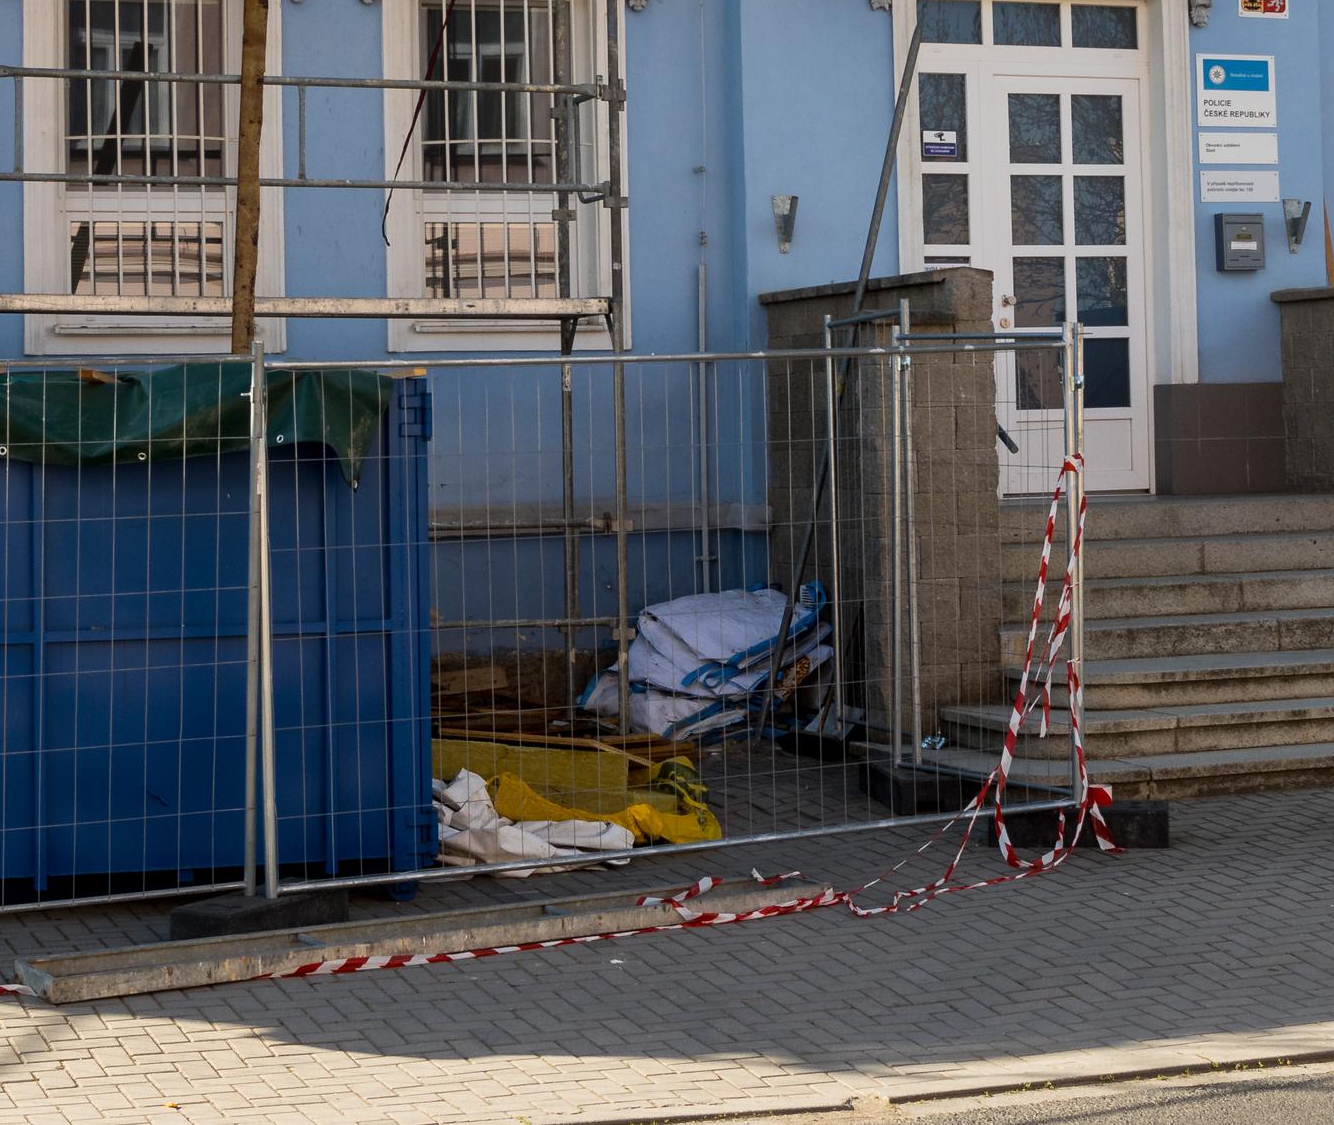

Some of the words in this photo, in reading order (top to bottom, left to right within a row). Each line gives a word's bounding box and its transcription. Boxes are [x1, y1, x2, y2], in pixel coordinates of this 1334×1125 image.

[1203, 99, 1232, 107] POLICIE
[1204, 108, 1228, 117] ČESKÉ
[1229, 110, 1271, 118] REPUBLIKY
